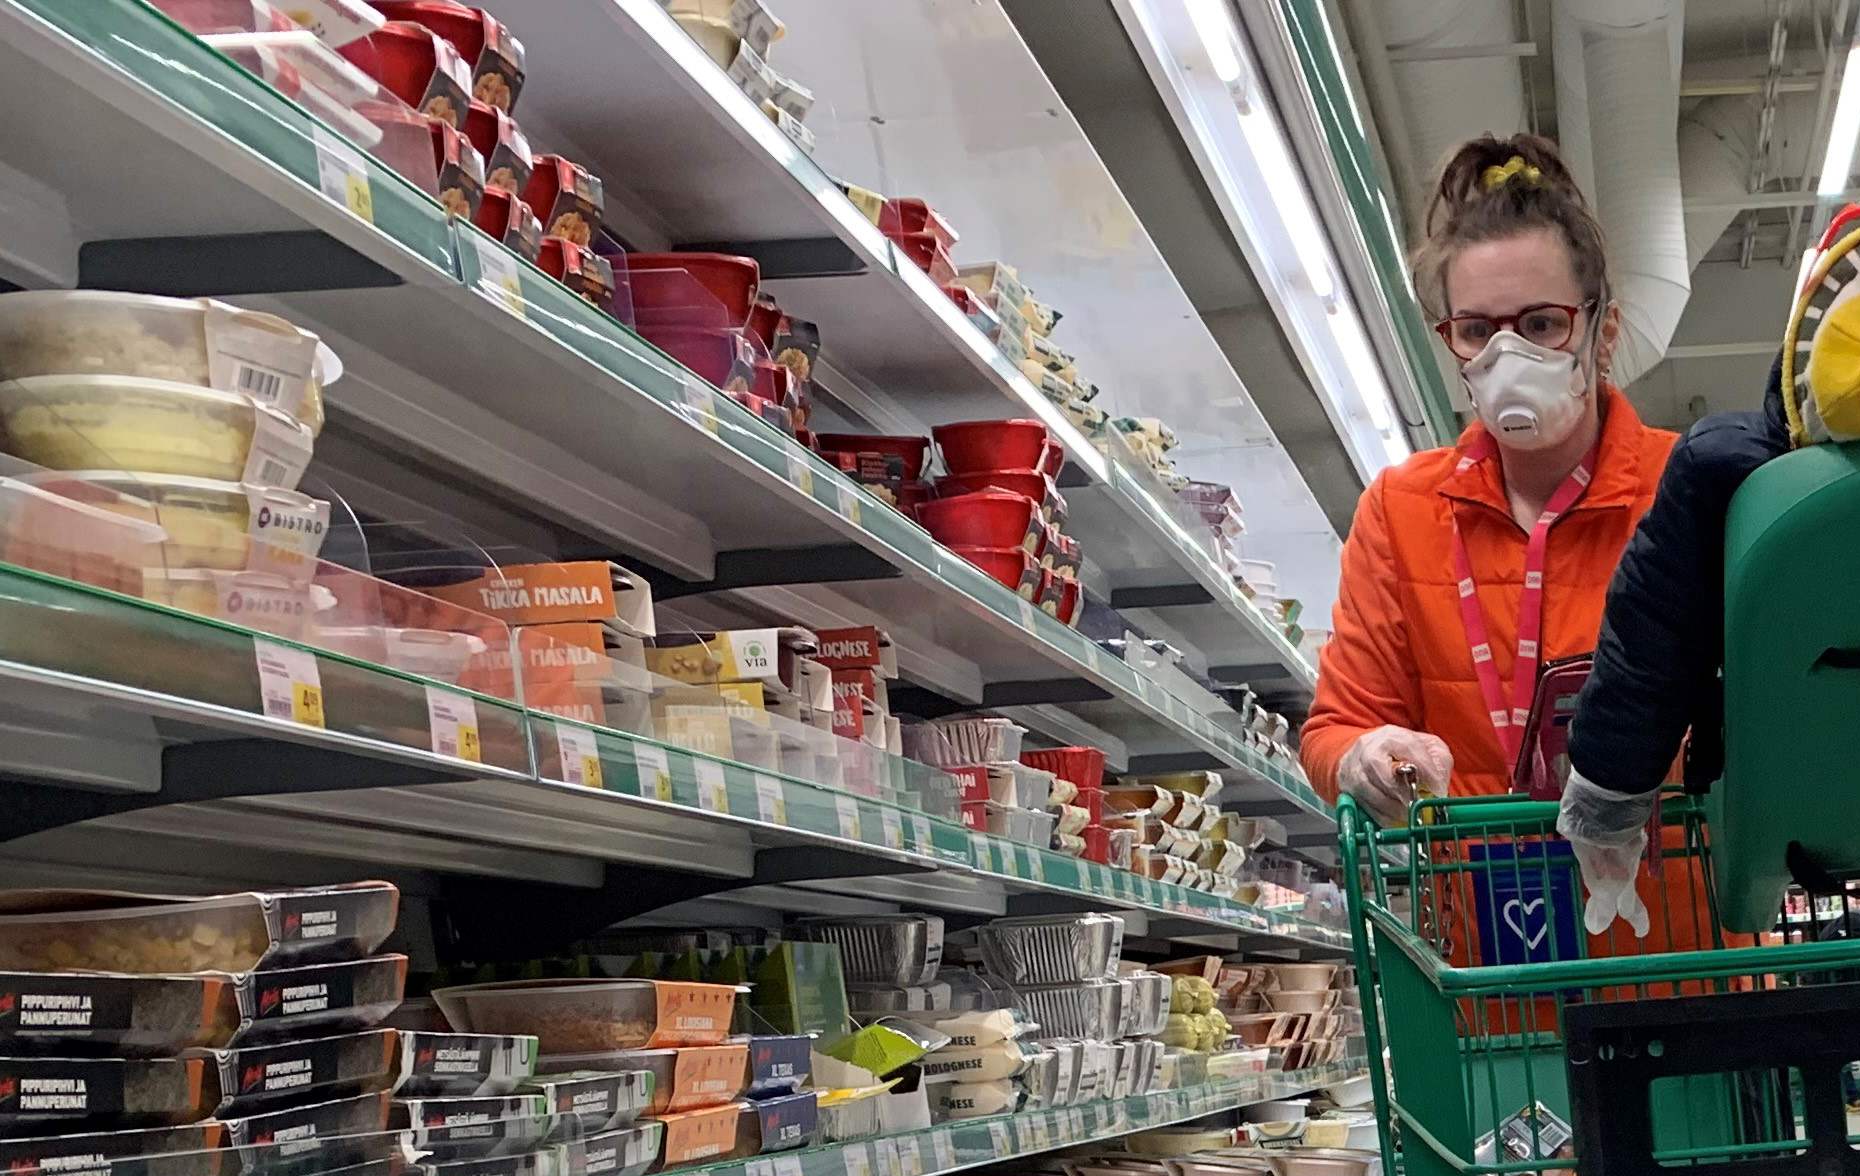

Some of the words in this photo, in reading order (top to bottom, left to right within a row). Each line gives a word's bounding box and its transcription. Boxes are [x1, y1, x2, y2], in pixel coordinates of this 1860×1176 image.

[273, 511, 322, 535] BISTRO
[534, 586, 604, 606] MASALA
[530, 646, 598, 667] MASALA
[744, 656, 768, 668] via
[21, 995, 80, 1009] PIPPURIPIHVI
[20, 1011, 92, 1025] PANNUPERUNAT
[924, 1058, 983, 1076] BOLOGNESE
[21, 1079, 76, 1093] PIPPURIPIHVI
[20, 1094, 87, 1109] PANNUPERUNAT
